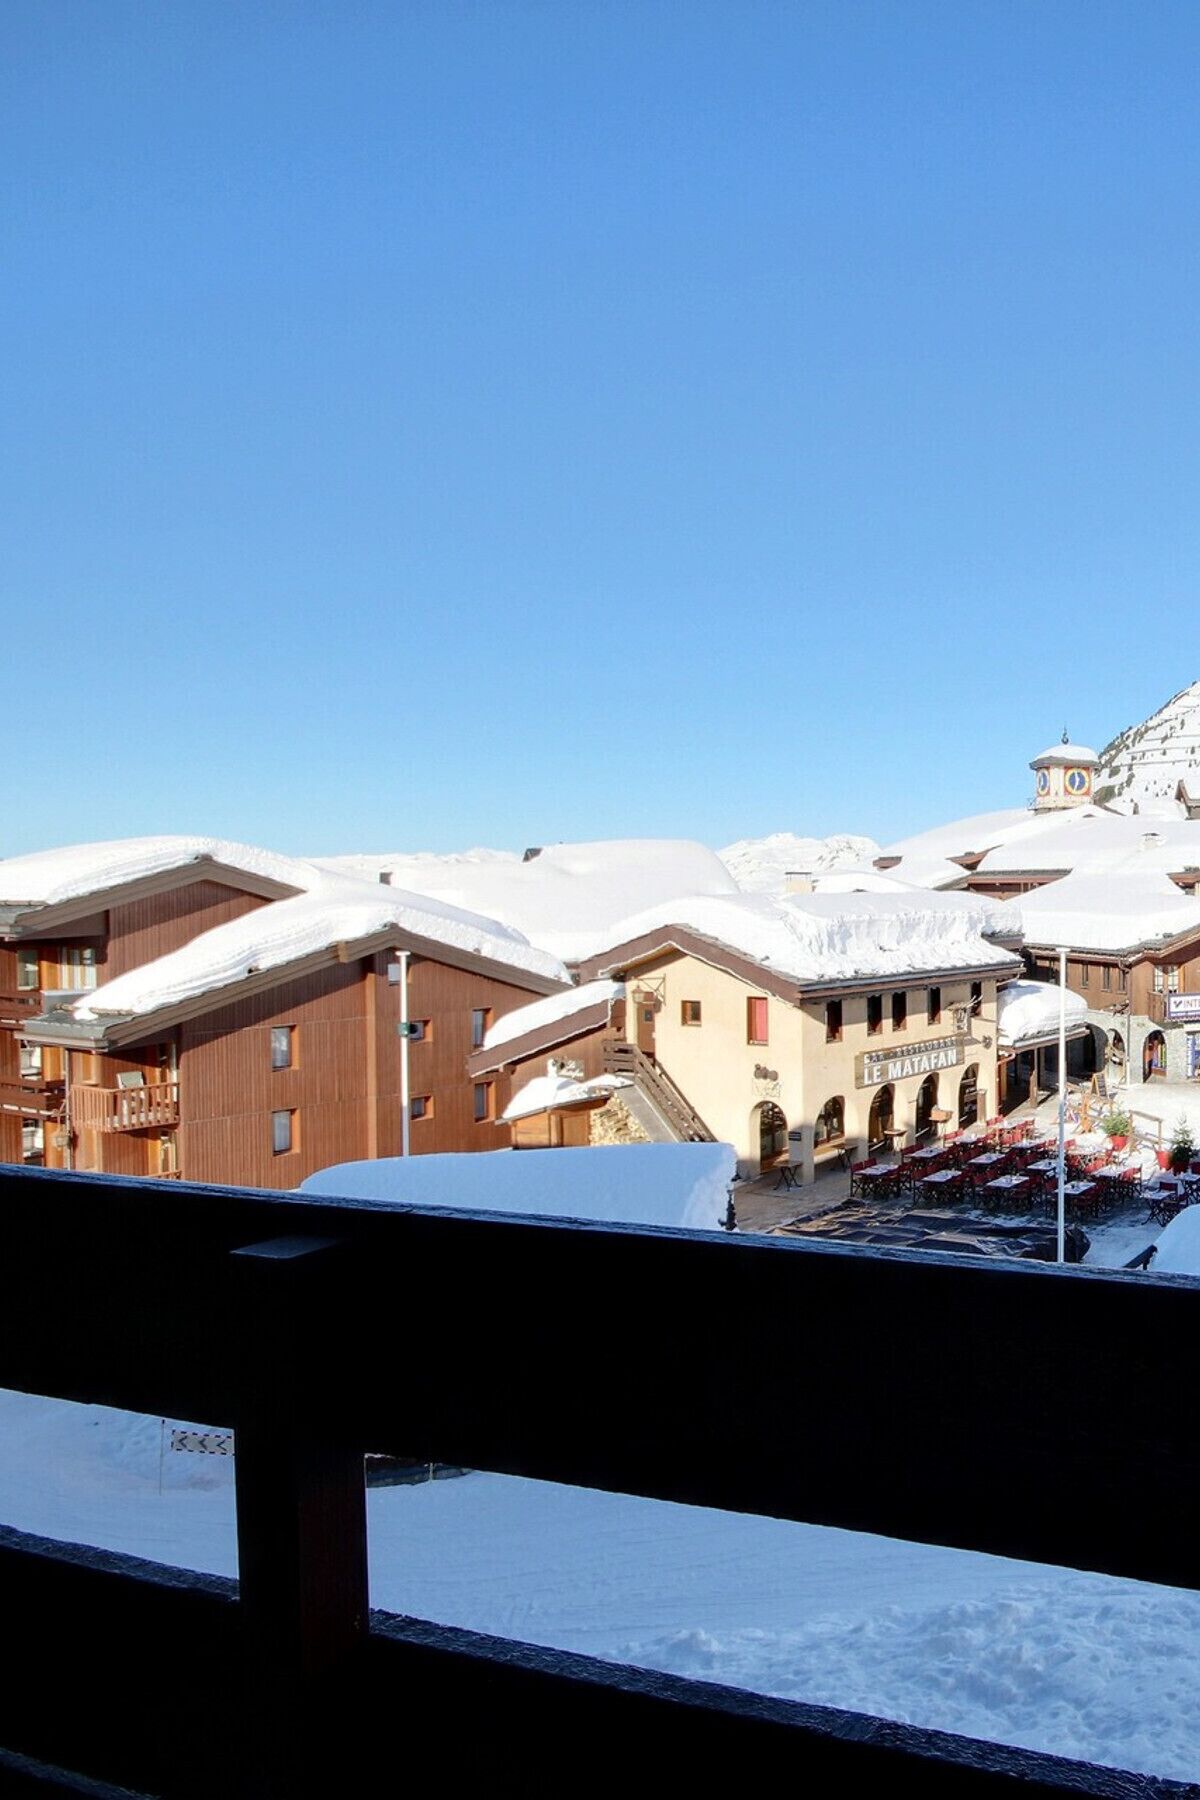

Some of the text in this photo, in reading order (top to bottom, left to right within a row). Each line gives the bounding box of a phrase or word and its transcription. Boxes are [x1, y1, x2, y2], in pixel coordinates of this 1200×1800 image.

[896, 1037, 957, 1057] RESTAURANT
[863, 1049, 957, 1085] LE MATAFAN
